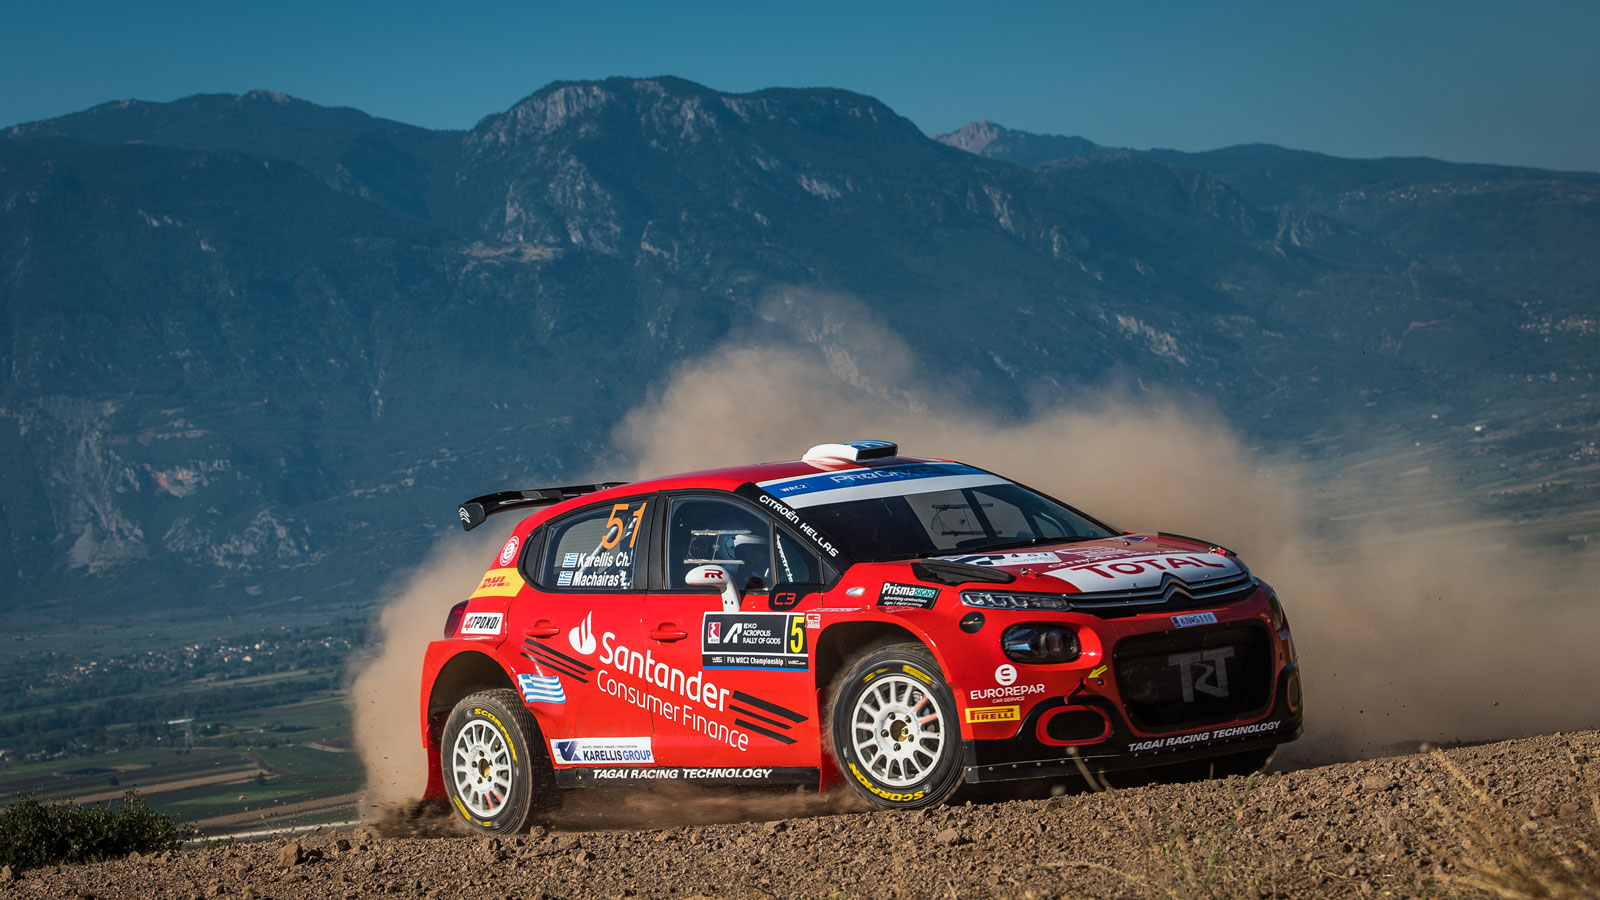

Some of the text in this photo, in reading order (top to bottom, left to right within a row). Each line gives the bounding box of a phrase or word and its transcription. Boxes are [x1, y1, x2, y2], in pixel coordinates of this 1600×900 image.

[602, 502, 647, 549] 51
[799, 523, 839, 557] HELLAS
[577, 552, 613, 567] Karellis
[1073, 554, 1226, 579] TOTAL
[572, 571, 620, 587] Machairas
[727, 656, 736, 664] FIA
[750, 657, 784, 667] Championship
[600, 632, 730, 712] Santander
[970, 684, 1045, 700] EUROREPAR
[597, 670, 749, 751] Consumer Finance
[970, 708, 1015, 720] PIRELLI
[1128, 720, 1281, 752] TAGAI RACING TECHNOLOGY
[593, 768, 773, 779] TAGAI RACING TECHNOLOGY
